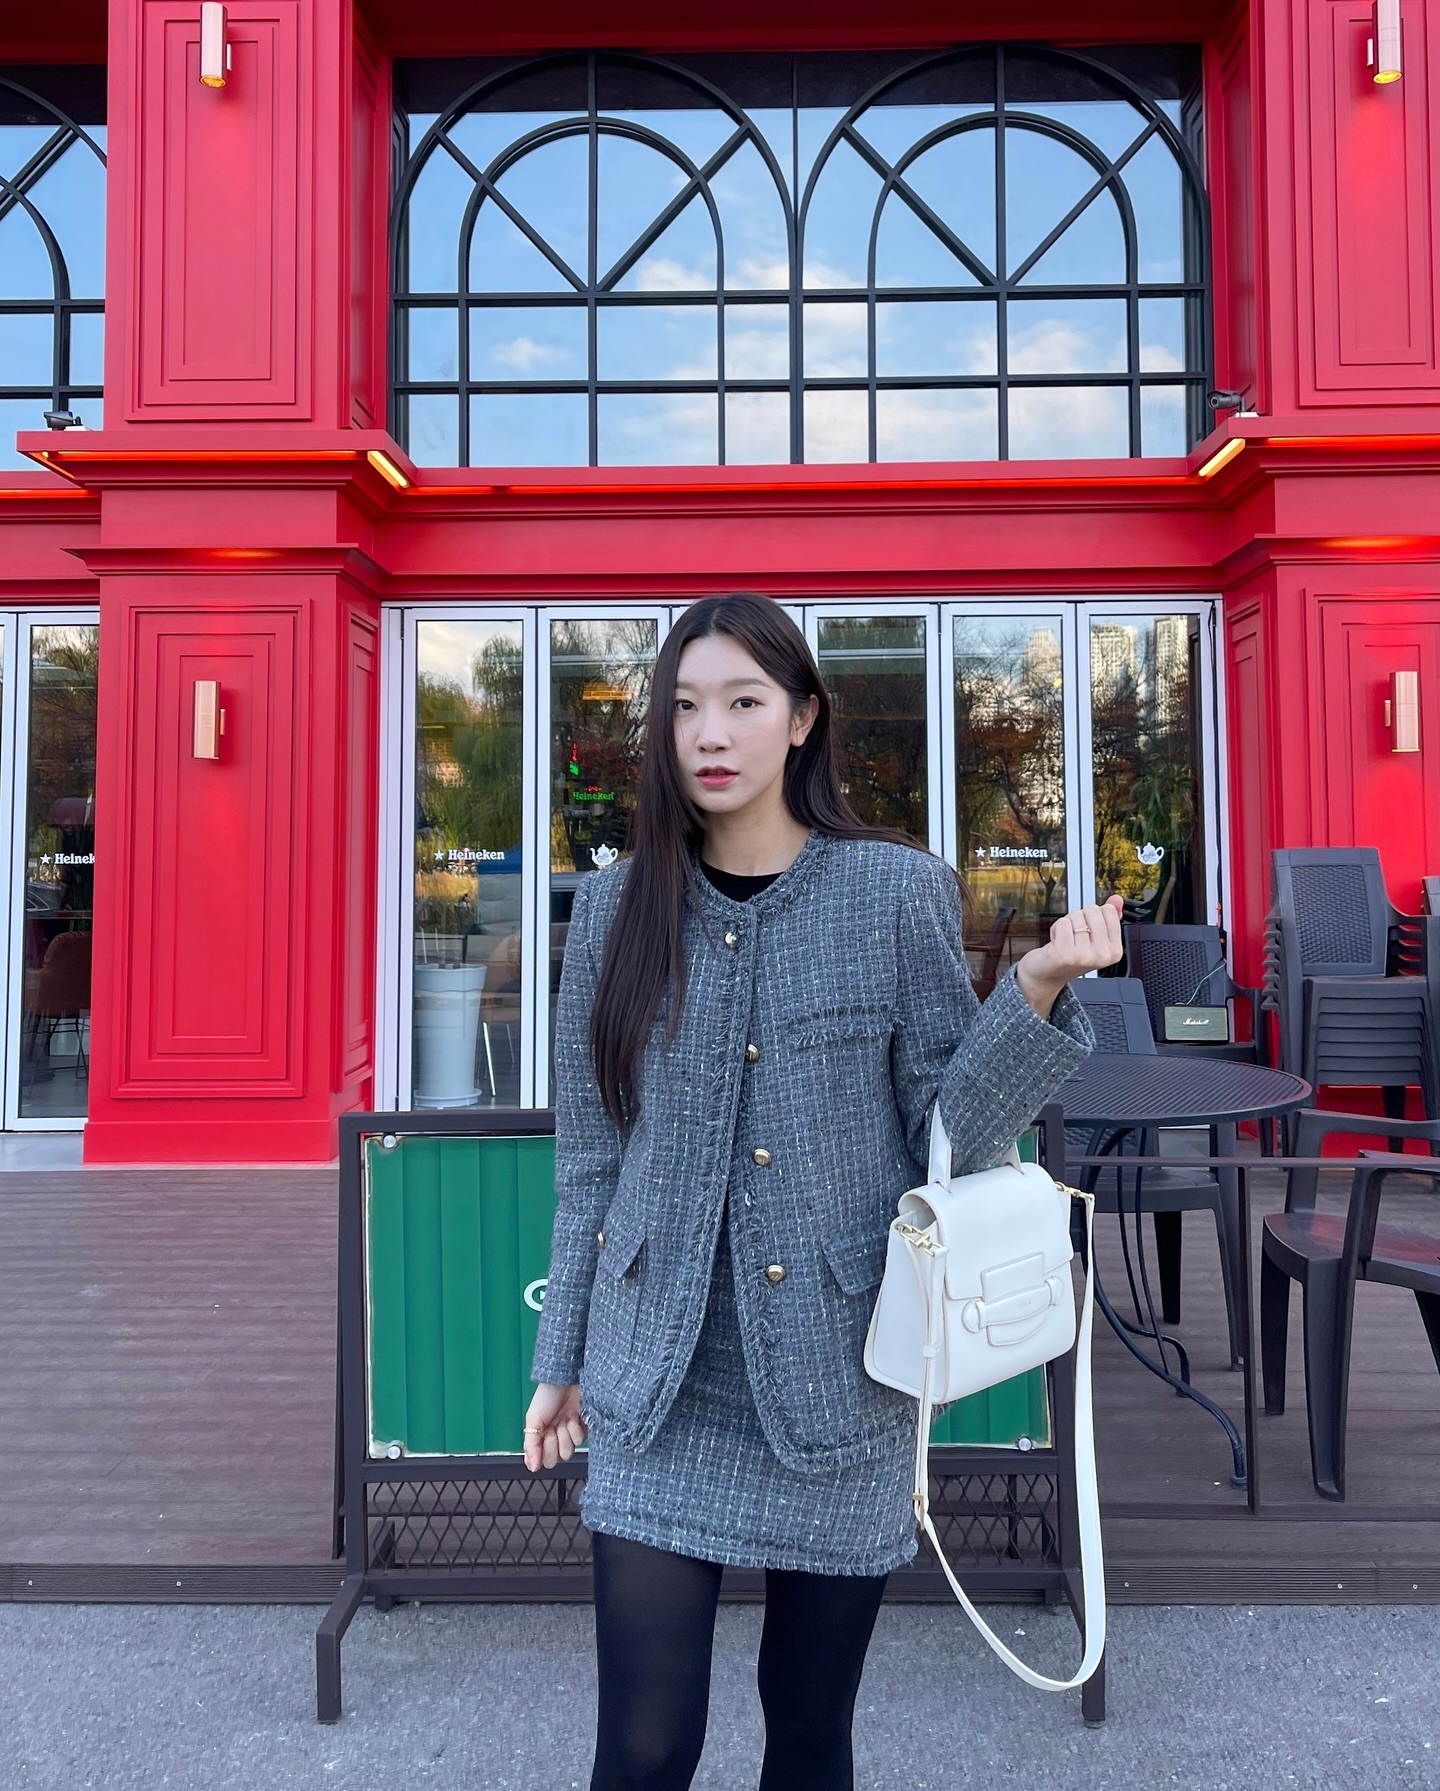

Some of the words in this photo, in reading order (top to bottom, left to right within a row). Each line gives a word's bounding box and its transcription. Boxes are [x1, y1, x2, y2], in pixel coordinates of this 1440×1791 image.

[572, 791, 615, 801] Heineken
[448, 849, 505, 860] Heineken
[990, 846, 1048, 858] Heineken
